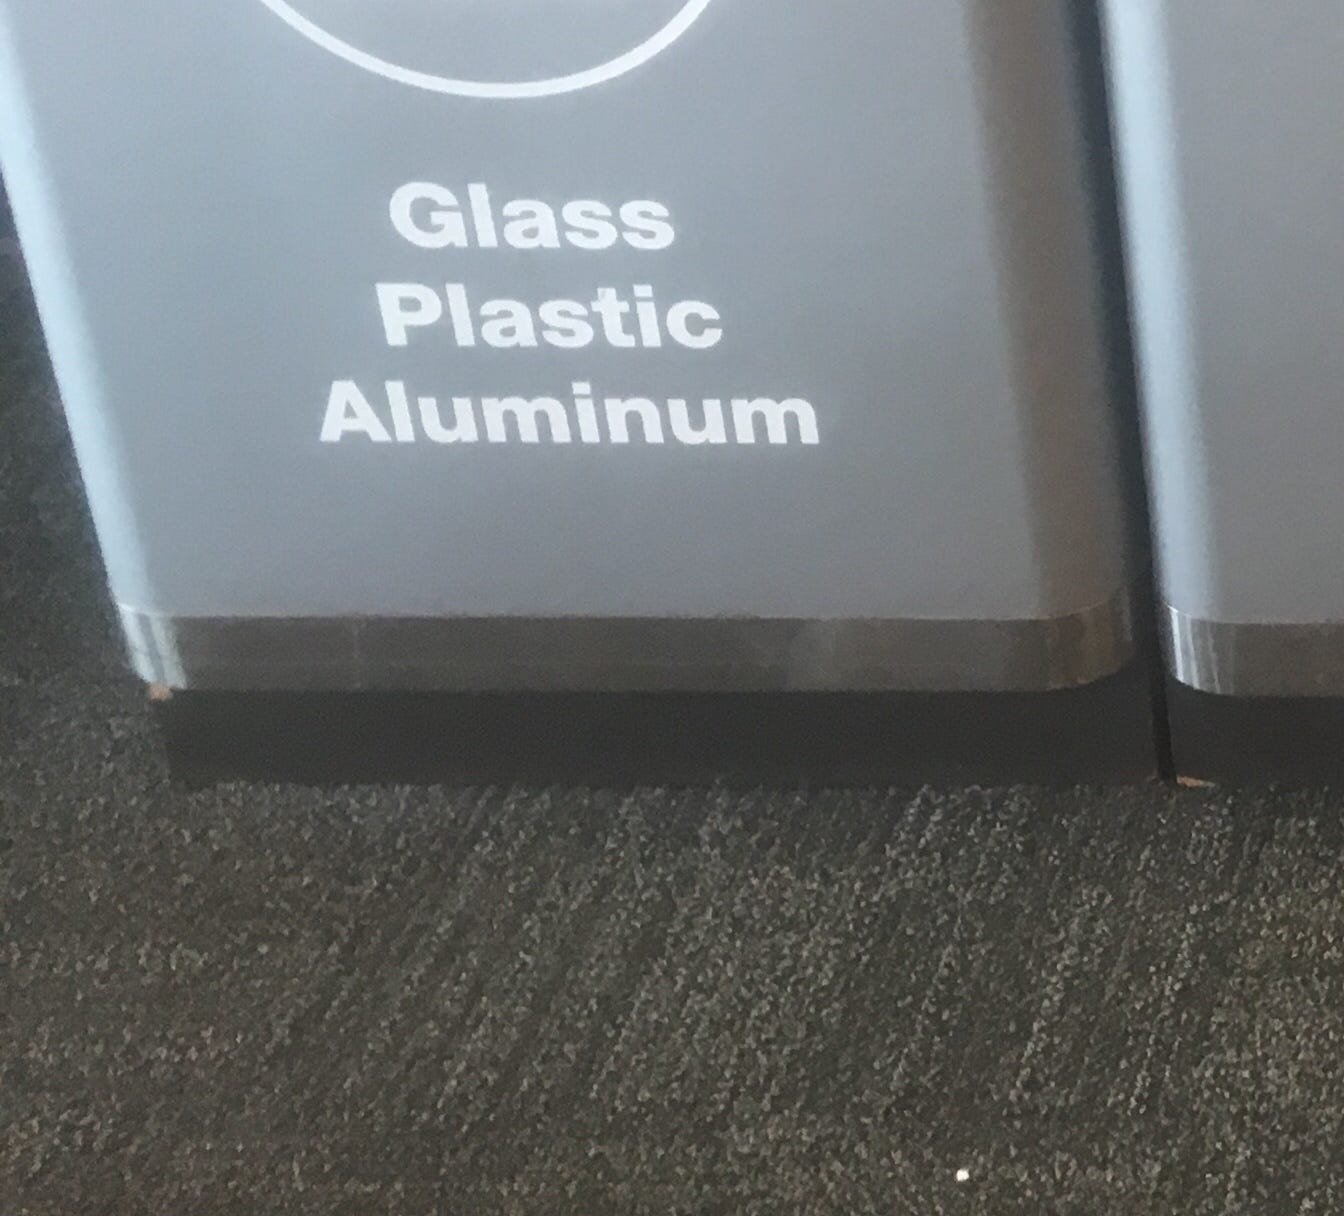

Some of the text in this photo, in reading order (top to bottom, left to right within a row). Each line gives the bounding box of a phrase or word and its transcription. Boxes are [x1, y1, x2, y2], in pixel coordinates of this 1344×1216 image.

[388, 181, 676, 250] Glass
[374, 282, 724, 349] Plastic
[318, 379, 821, 445] Aluminum
